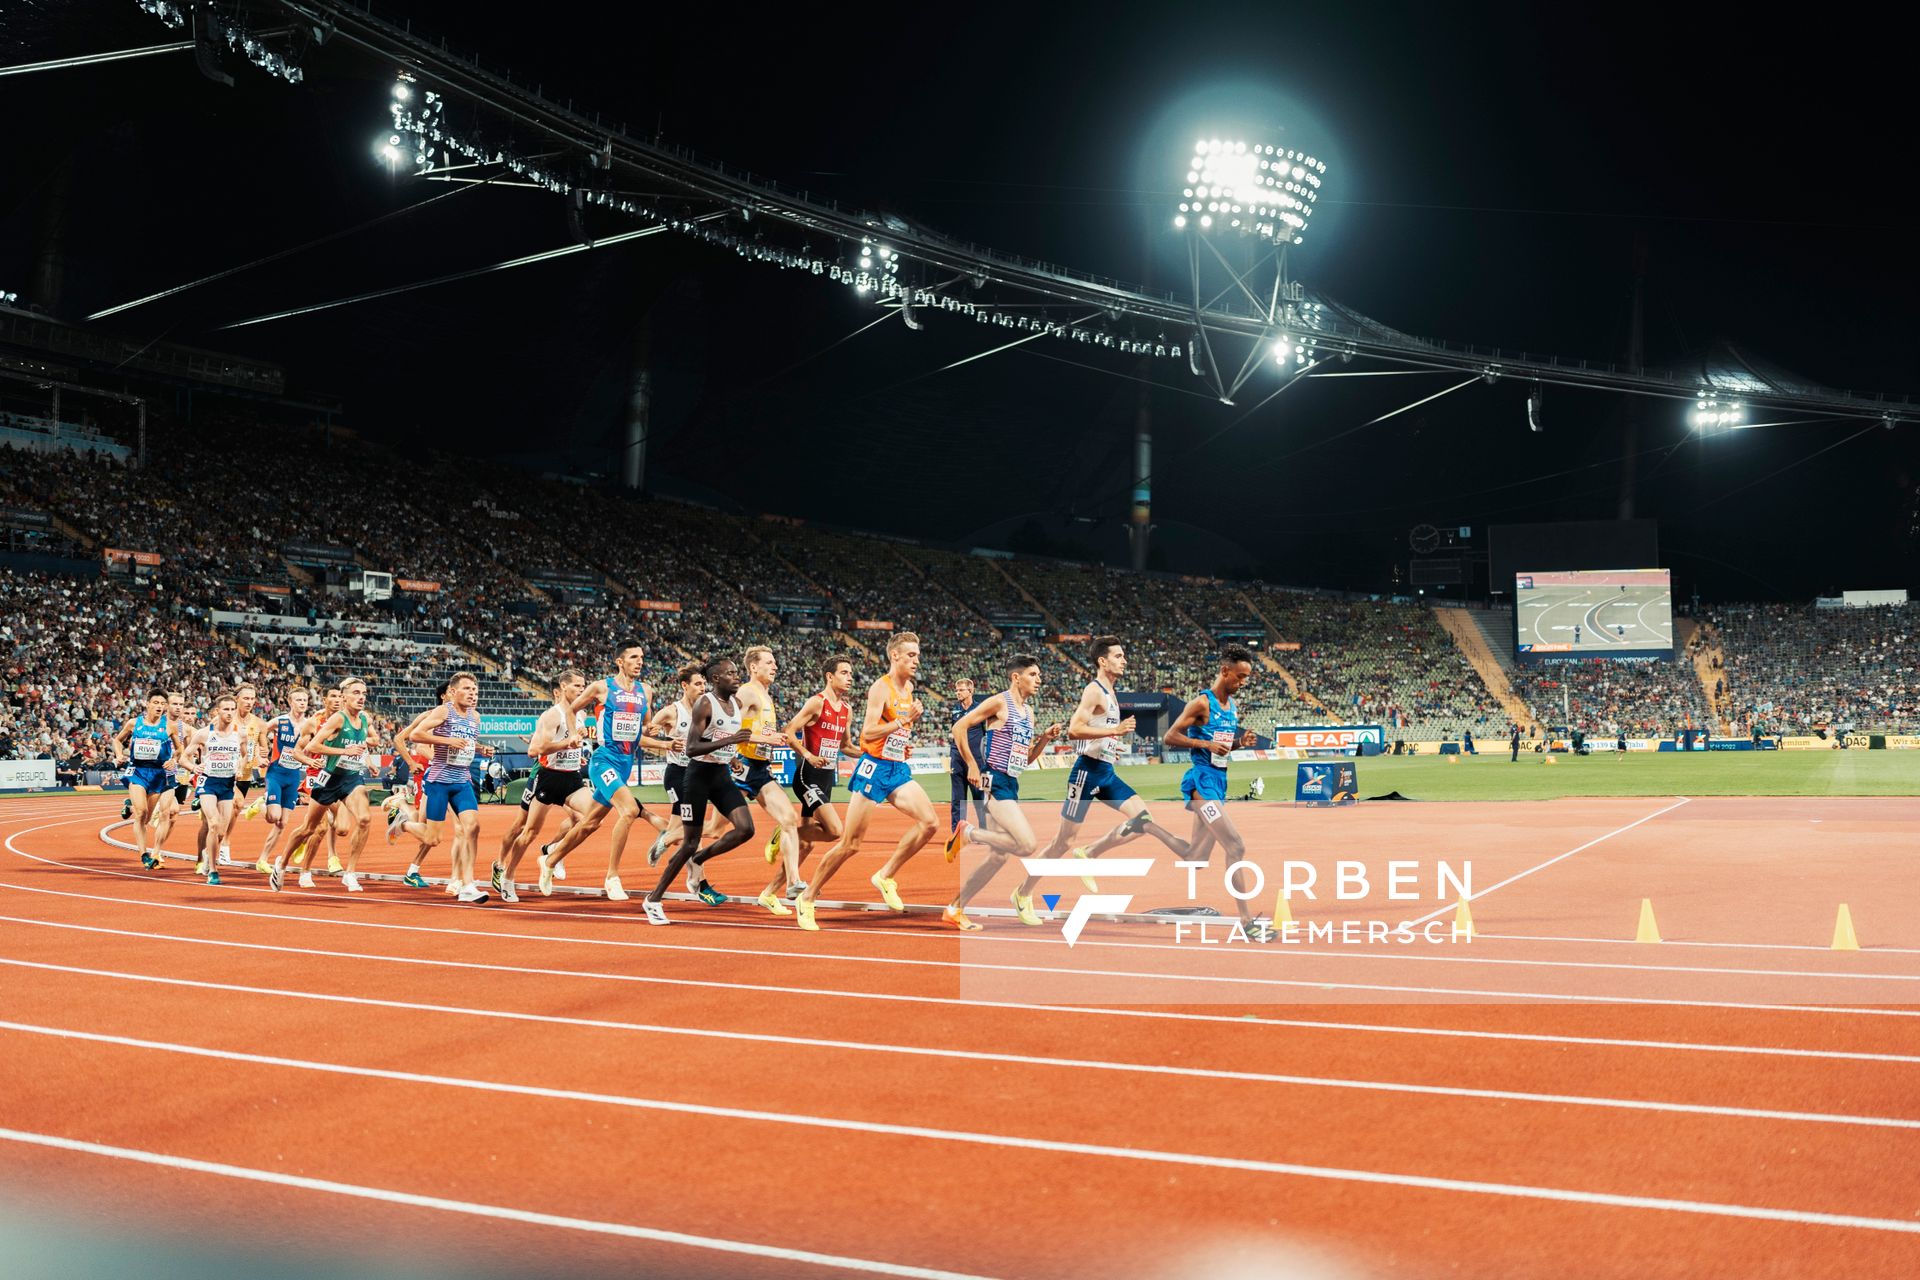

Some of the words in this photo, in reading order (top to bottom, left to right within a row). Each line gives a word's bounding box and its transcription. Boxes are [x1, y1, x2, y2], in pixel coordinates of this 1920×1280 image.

[615, 694, 643, 705] SERBIA
[478, 719, 532, 732] mpiastadion
[1295, 733, 1354, 746] SPAR
[1846, 737, 1867, 746] DAC
[138, 745, 155, 754] RIVA
[1403, 743, 1420, 752] DAC
[1508, 742, 1533, 750] AAC
[556, 751, 580, 760] RAESS
[862, 763, 873, 775] 10
[15, 771, 48, 782] REGUPOL
[602, 770, 616, 783] 23
[981, 777, 990, 789] 12
[1069, 787, 1076, 799] 3
[681, 806, 692, 818] 22
[1203, 805, 1217, 819] 18
